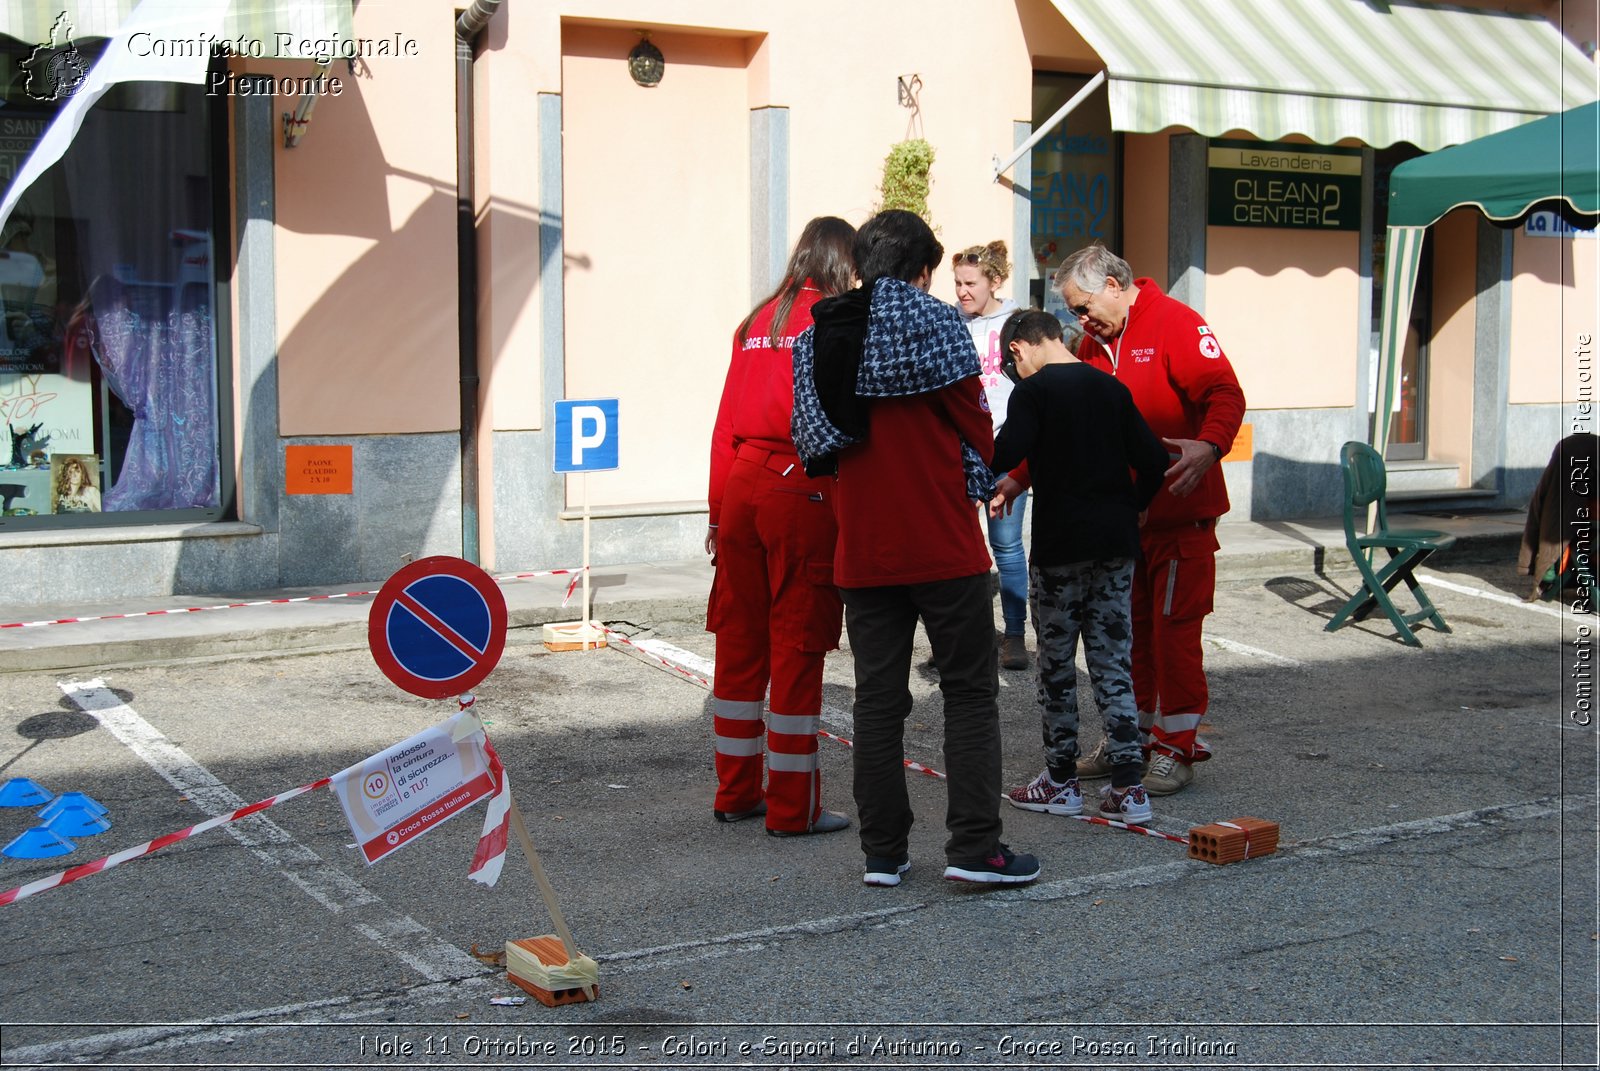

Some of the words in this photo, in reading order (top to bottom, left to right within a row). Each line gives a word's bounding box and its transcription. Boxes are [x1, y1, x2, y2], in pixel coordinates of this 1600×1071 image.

[4, 119, 52, 136] SANT
[1240, 151, 1332, 171] Lavanderia
[1234, 179, 1319, 203] CLEAN
[1322, 184, 1341, 226] 2
[1233, 204, 1319, 224] CENTER
[571, 406, 607, 465] P
[390, 741, 426, 763] indosso
[392, 766, 402, 774] la
[403, 748, 435, 768] cintura
[398, 774, 407, 786] di
[407, 752, 455, 781] sicurezza...
[368, 778, 383, 792] 10
[403, 791, 410, 799] e
[409, 777, 429, 794] TU?
[370, 792, 396, 810] impegni
[398, 819, 421, 836] Croce
[420, 805, 444, 823] Rossa
[443, 790, 470, 809] Italiana
